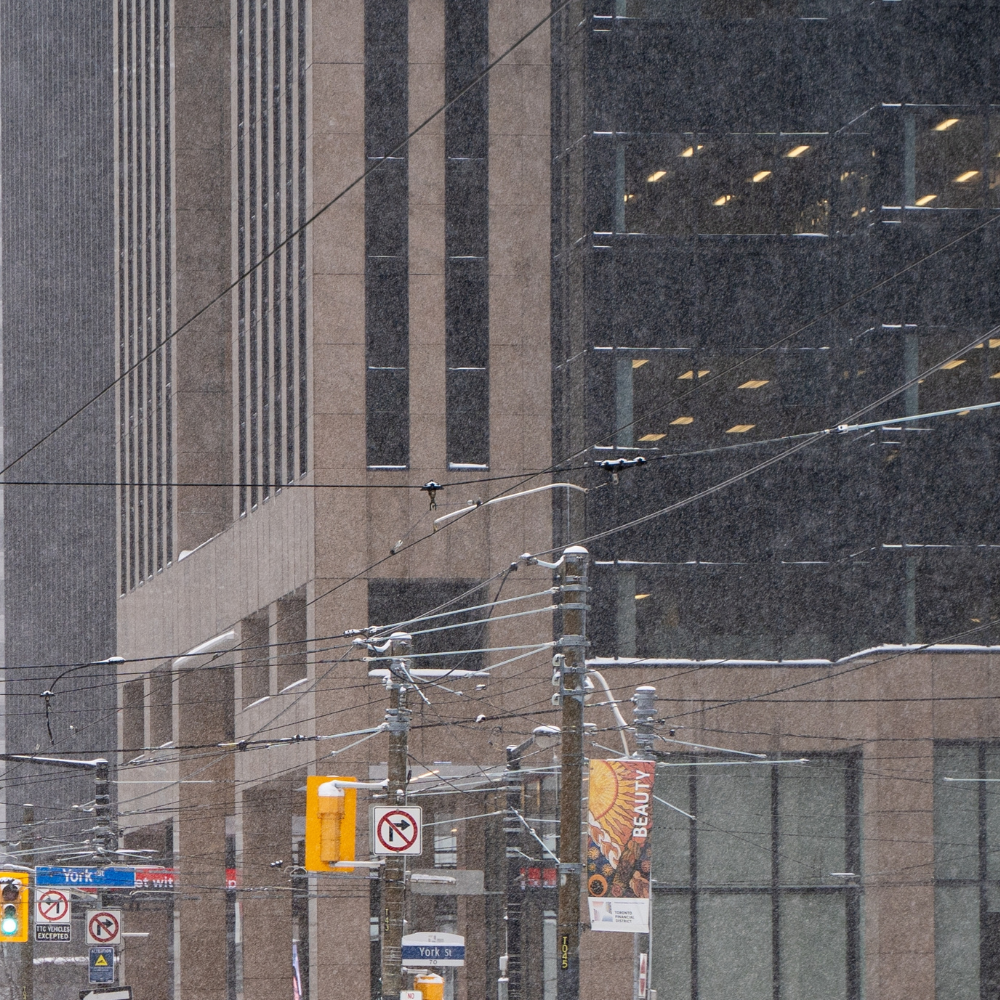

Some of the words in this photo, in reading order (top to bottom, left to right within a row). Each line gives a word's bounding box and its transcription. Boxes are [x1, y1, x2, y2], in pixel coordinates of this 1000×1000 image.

[633, 769, 651, 838] BEAUTY
[62, 868, 93, 882] York
[152, 876, 174, 888] wit
[37, 932, 69, 940] EXCEPTED
[419, 946, 440, 957] York
[444, 948, 452, 957] St
[561, 936, 569, 969] T045
